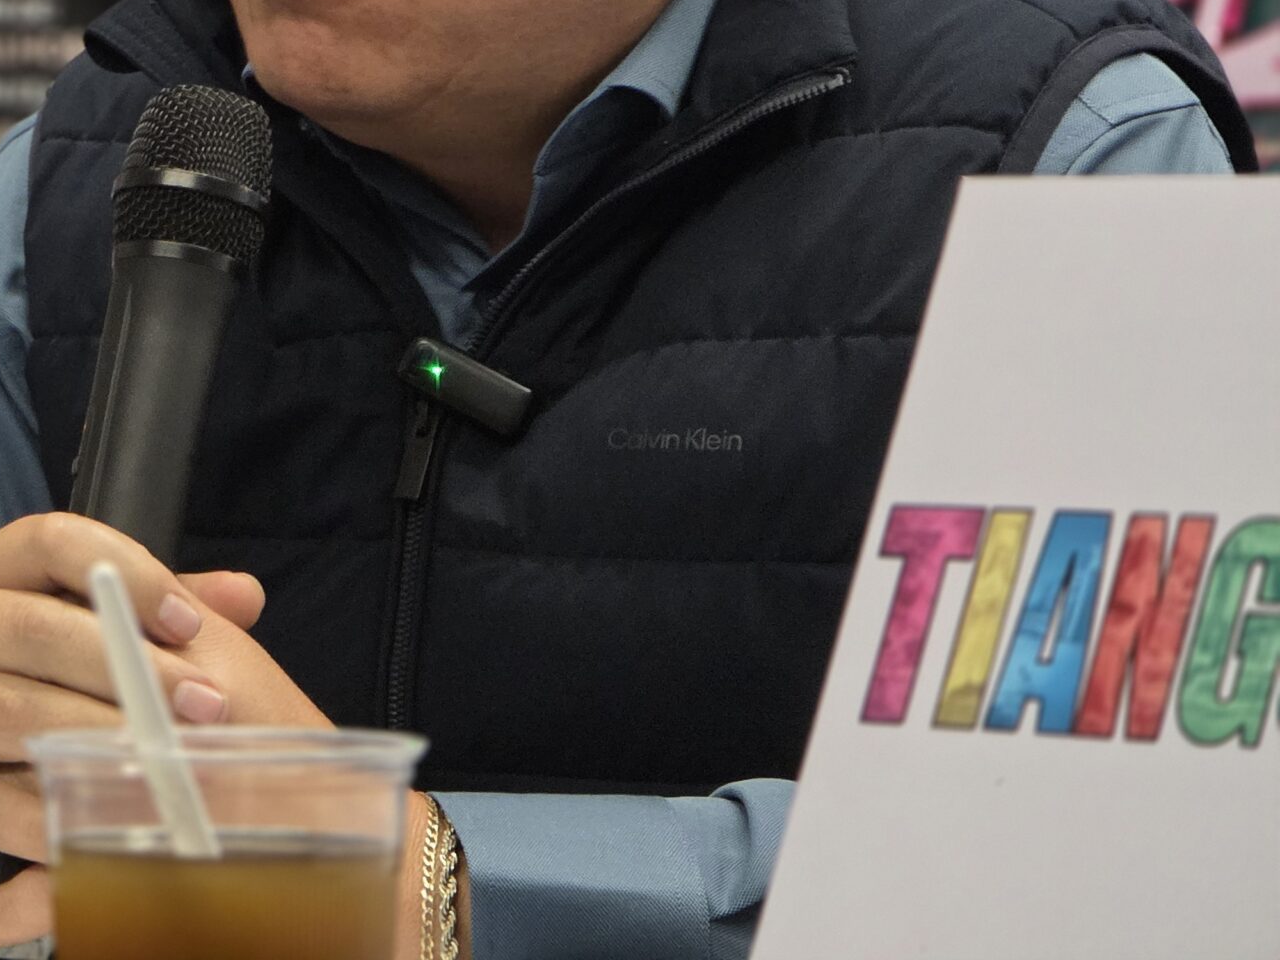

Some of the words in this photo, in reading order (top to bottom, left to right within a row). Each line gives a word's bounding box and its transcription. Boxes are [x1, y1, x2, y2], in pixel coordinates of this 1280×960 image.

[606, 428, 680, 452] Calvin
[686, 427, 744, 453] Klein
[859, 502, 1280, 751] TIANG
